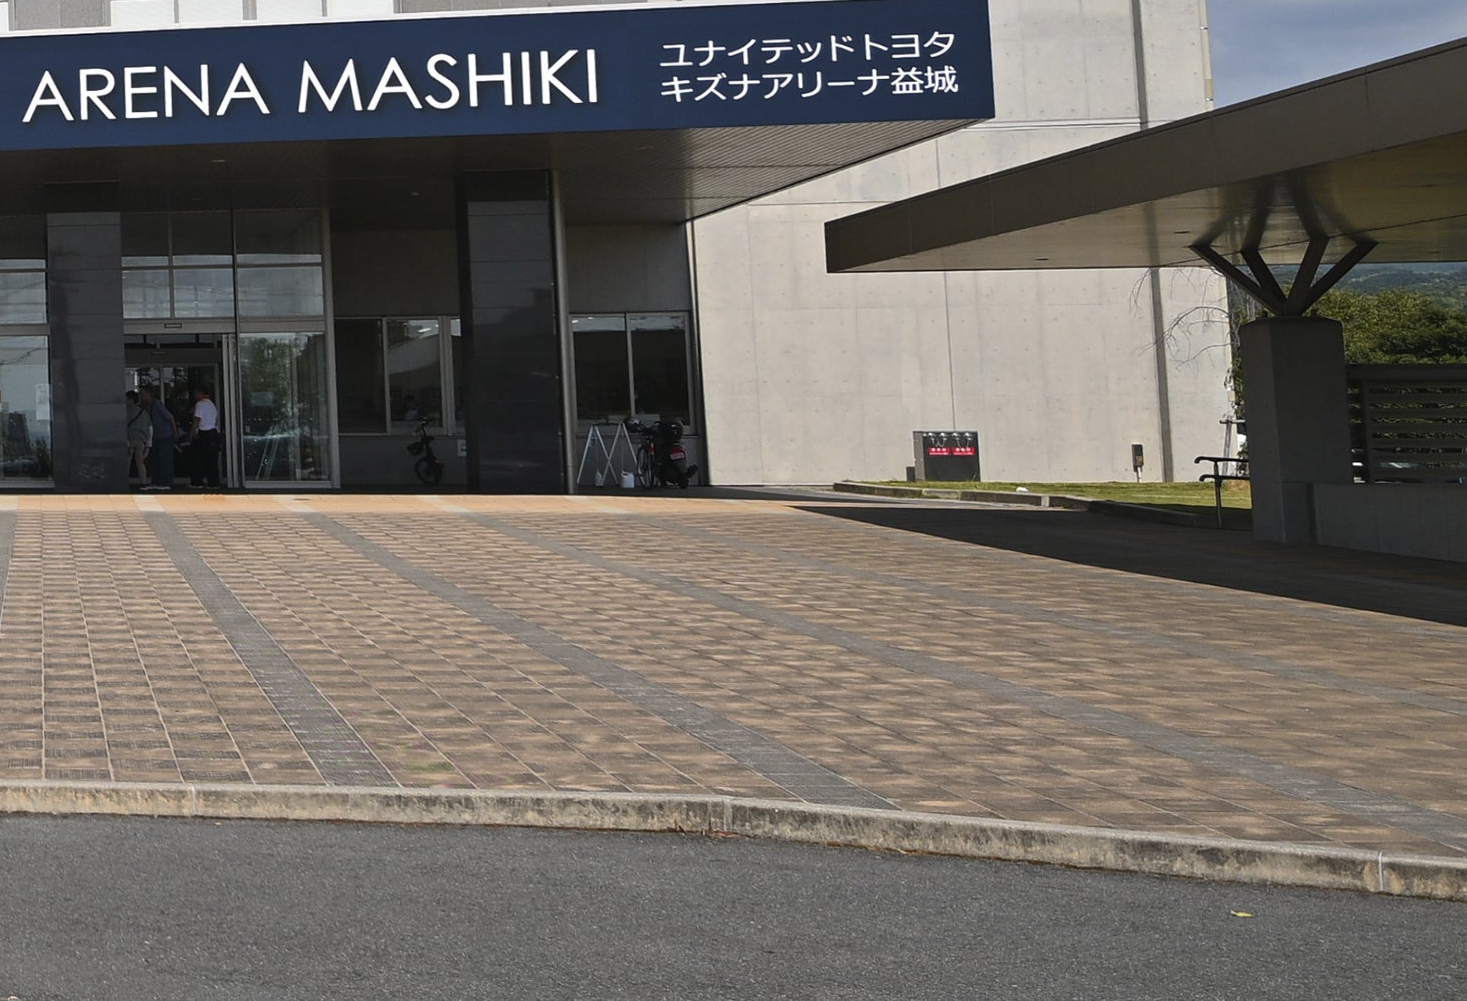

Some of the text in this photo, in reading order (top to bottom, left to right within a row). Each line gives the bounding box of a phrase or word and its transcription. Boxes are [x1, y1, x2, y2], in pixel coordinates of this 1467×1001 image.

[659, 31, 955, 67] ユナイテッドトヨタ
[22, 62, 270, 122] ARENA
[297, 48, 599, 113] MASHIKI
[660, 65, 959, 103] キズナアリーナ益城
